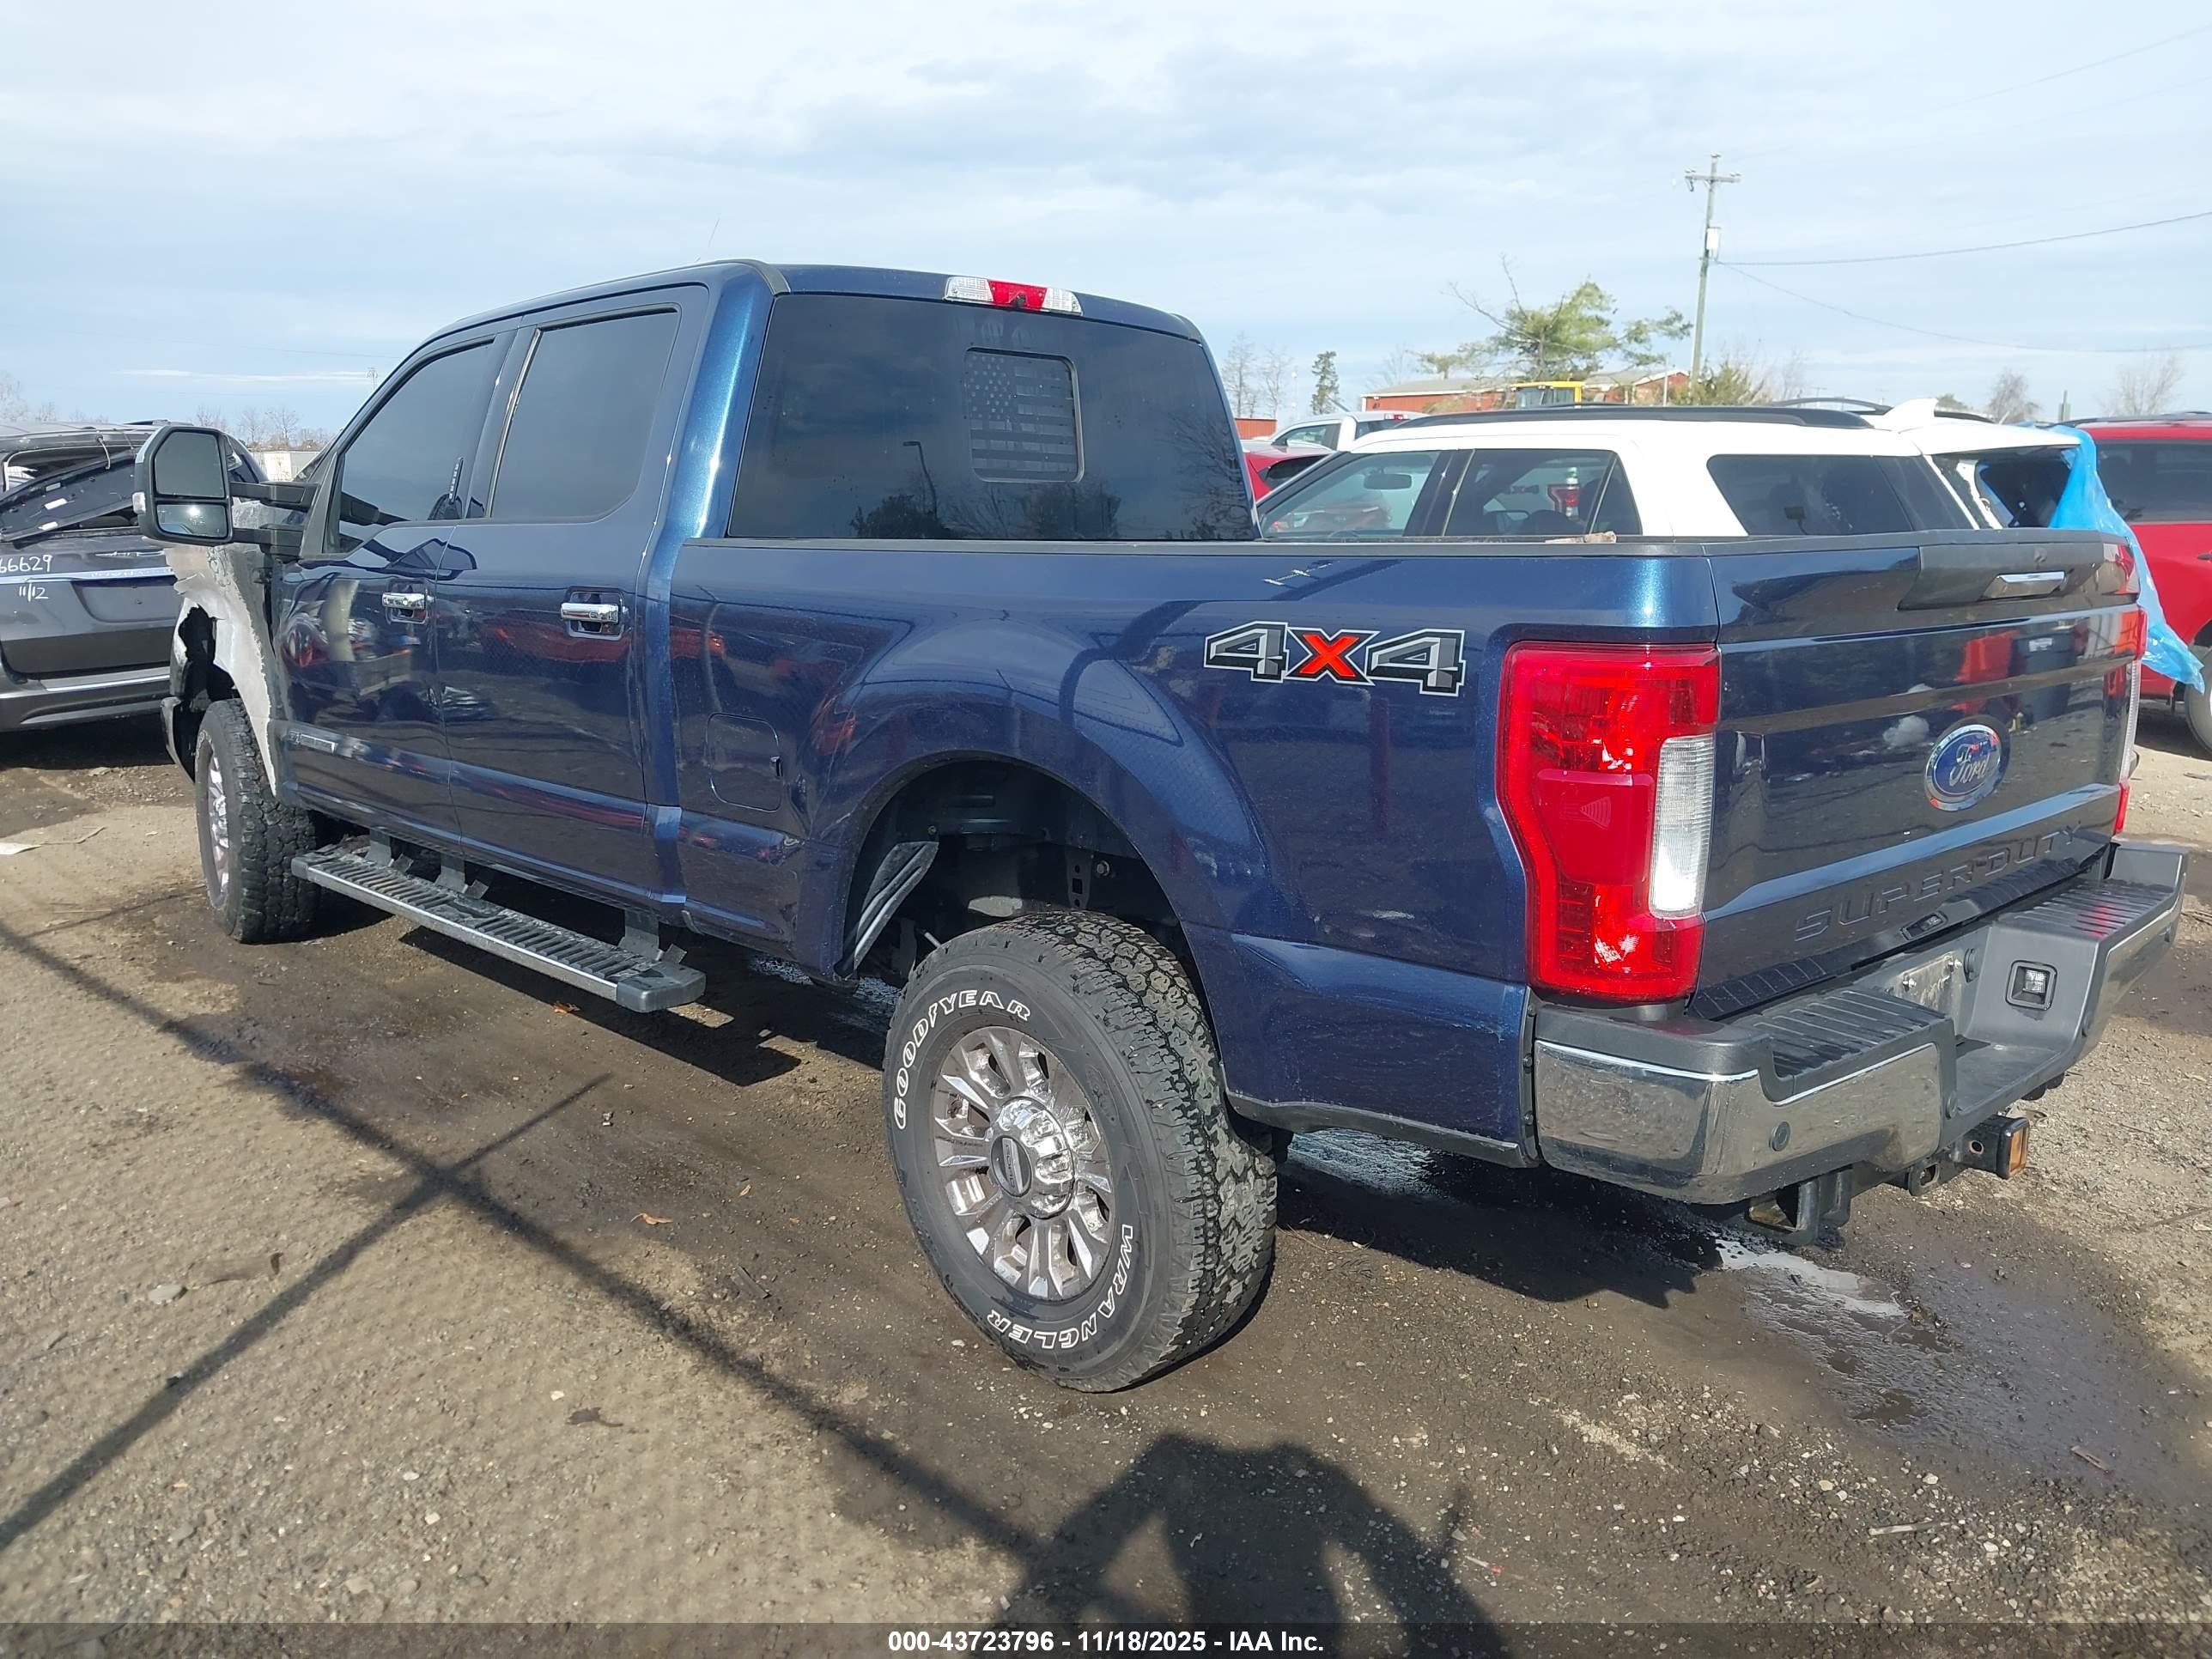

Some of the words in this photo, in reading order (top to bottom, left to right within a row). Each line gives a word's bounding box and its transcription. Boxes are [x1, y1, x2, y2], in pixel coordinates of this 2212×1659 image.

[19, 583, 49, 602] 11/12
[1948, 743, 1991, 787] Ford
[1794, 863, 1974, 942] SUPER
[894, 989, 1031, 1130] GOODYEAR
[987, 1224, 1133, 1350] WRANGLER
